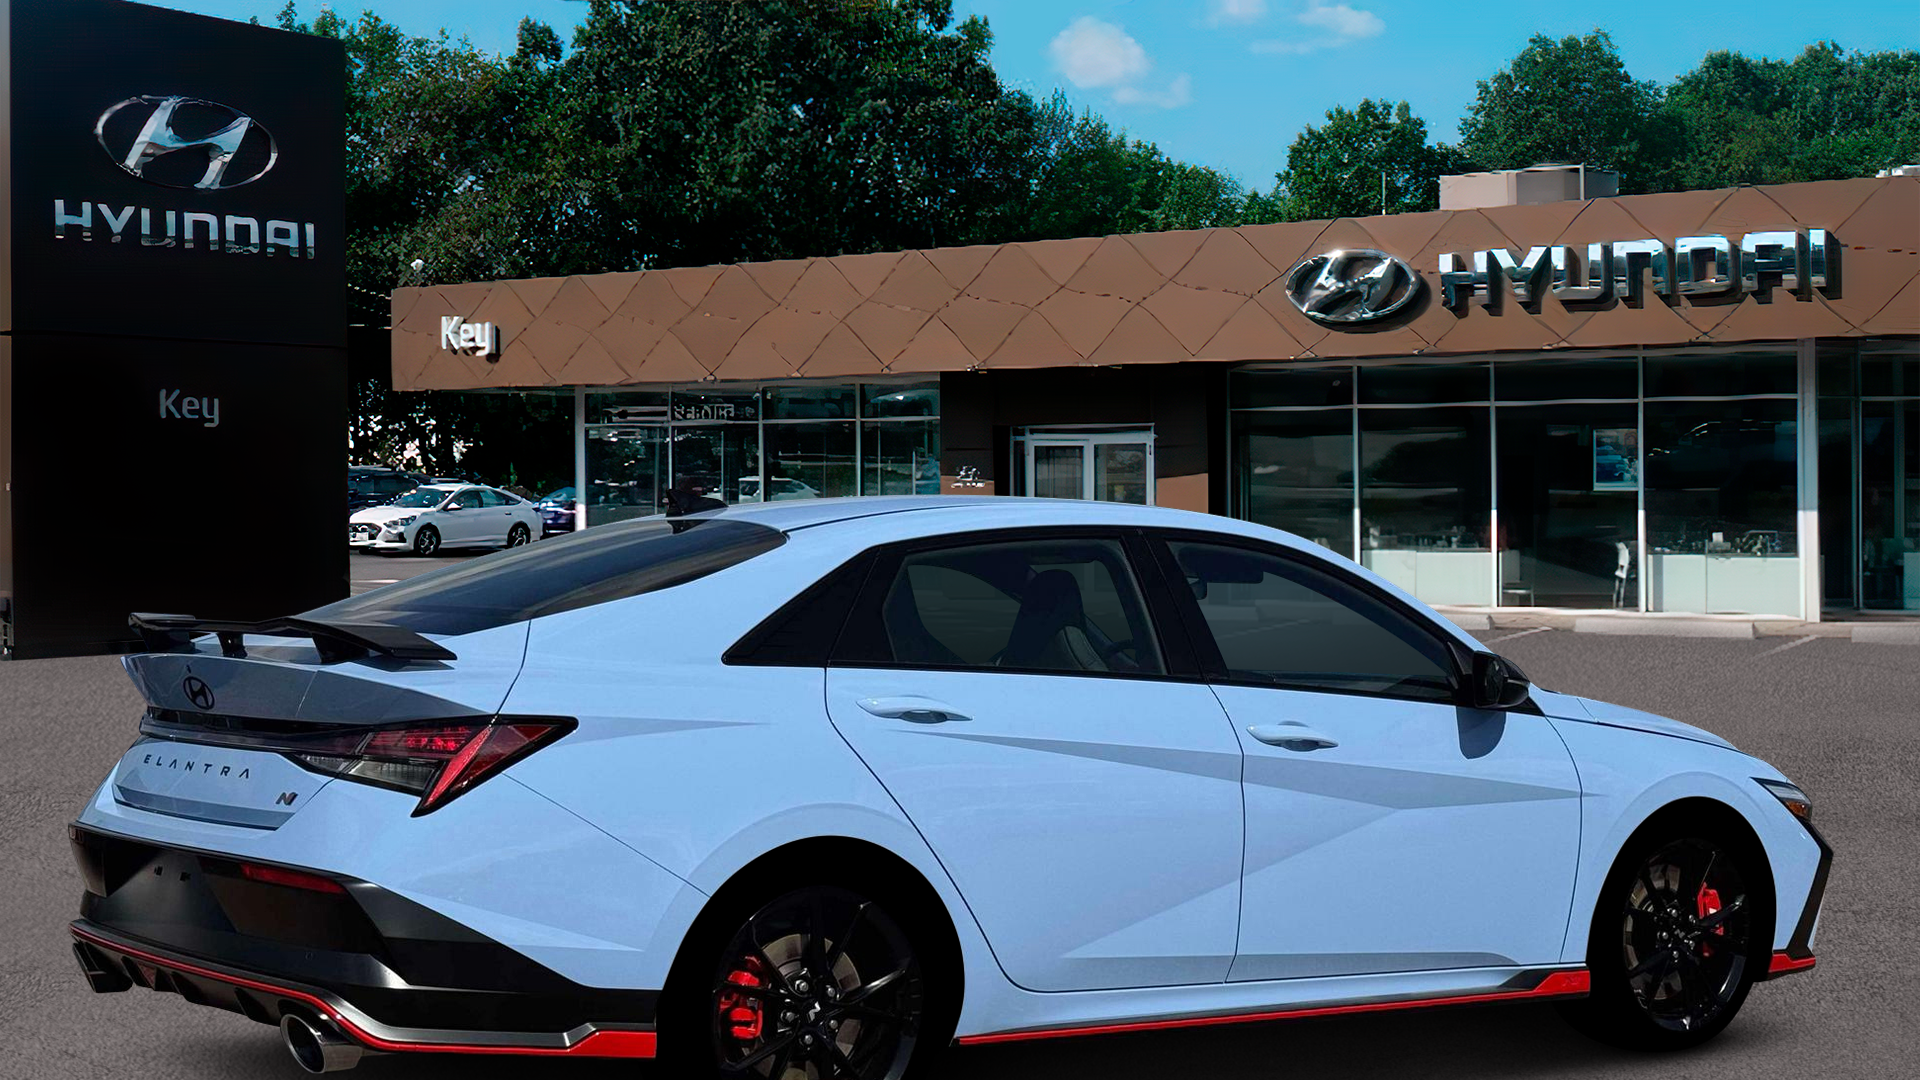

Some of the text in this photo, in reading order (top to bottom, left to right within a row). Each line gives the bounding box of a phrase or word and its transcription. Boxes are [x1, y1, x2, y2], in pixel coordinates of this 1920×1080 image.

[54, 199, 314, 259] HYUNDAI
[1438, 228, 1838, 316] HYUNDAI
[441, 316, 492, 357] Key
[159, 388, 219, 427] Key
[144, 754, 250, 779] ELANTRA
[275, 791, 299, 806] N
